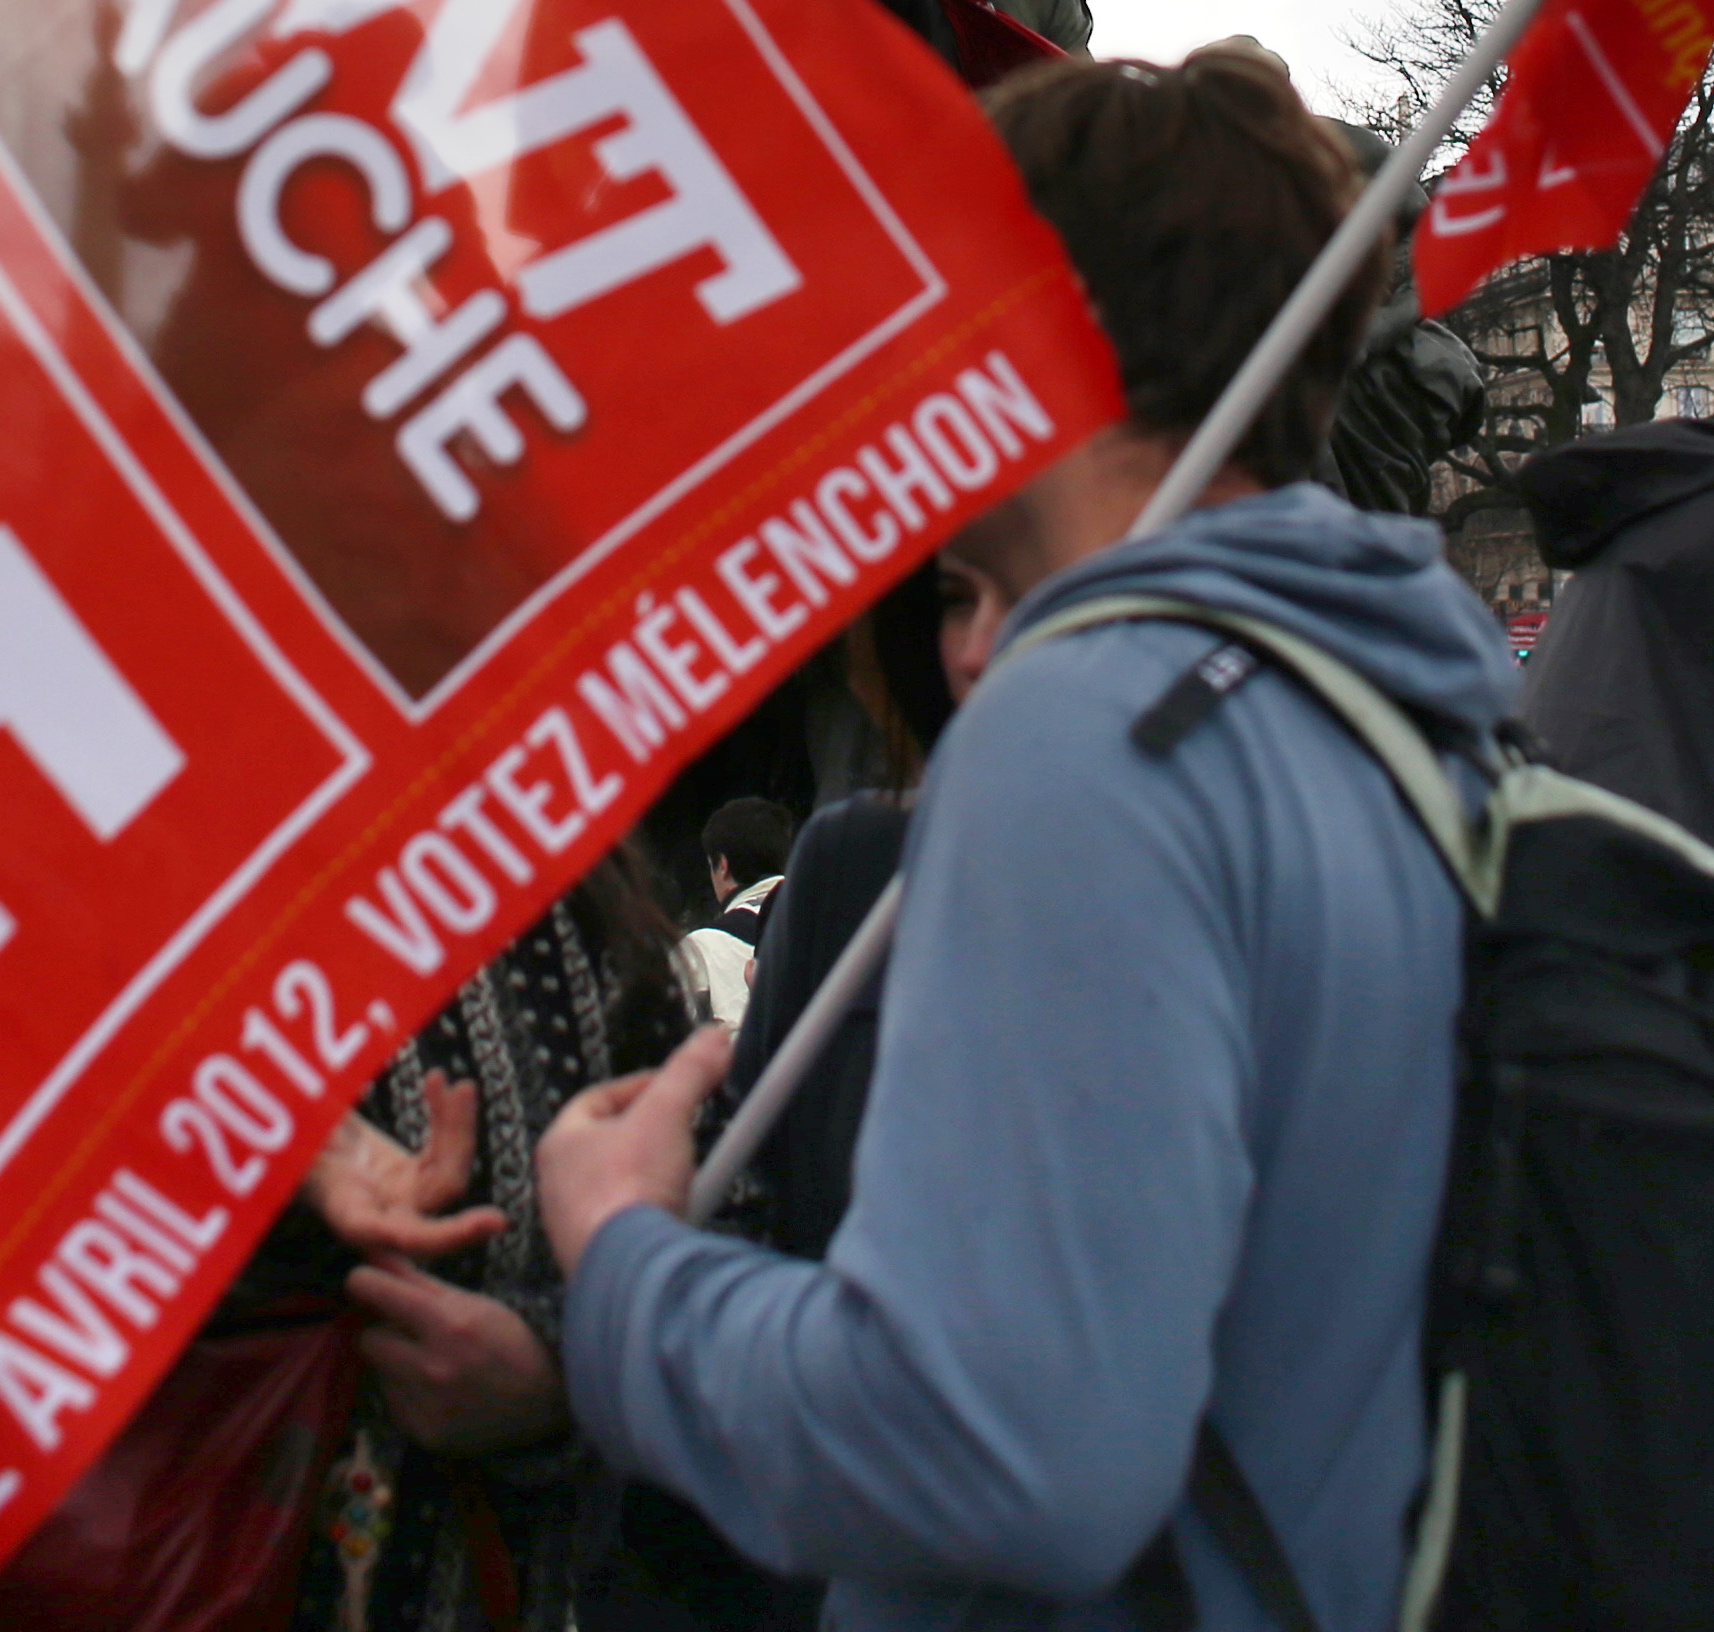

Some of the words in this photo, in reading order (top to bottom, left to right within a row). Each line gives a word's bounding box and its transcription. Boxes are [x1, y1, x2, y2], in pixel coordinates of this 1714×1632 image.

[160, 956, 400, 1194] 2012,
[343, 734, 625, 978] VOTEZ
[576, 350, 1057, 768] MÉLENCHON
